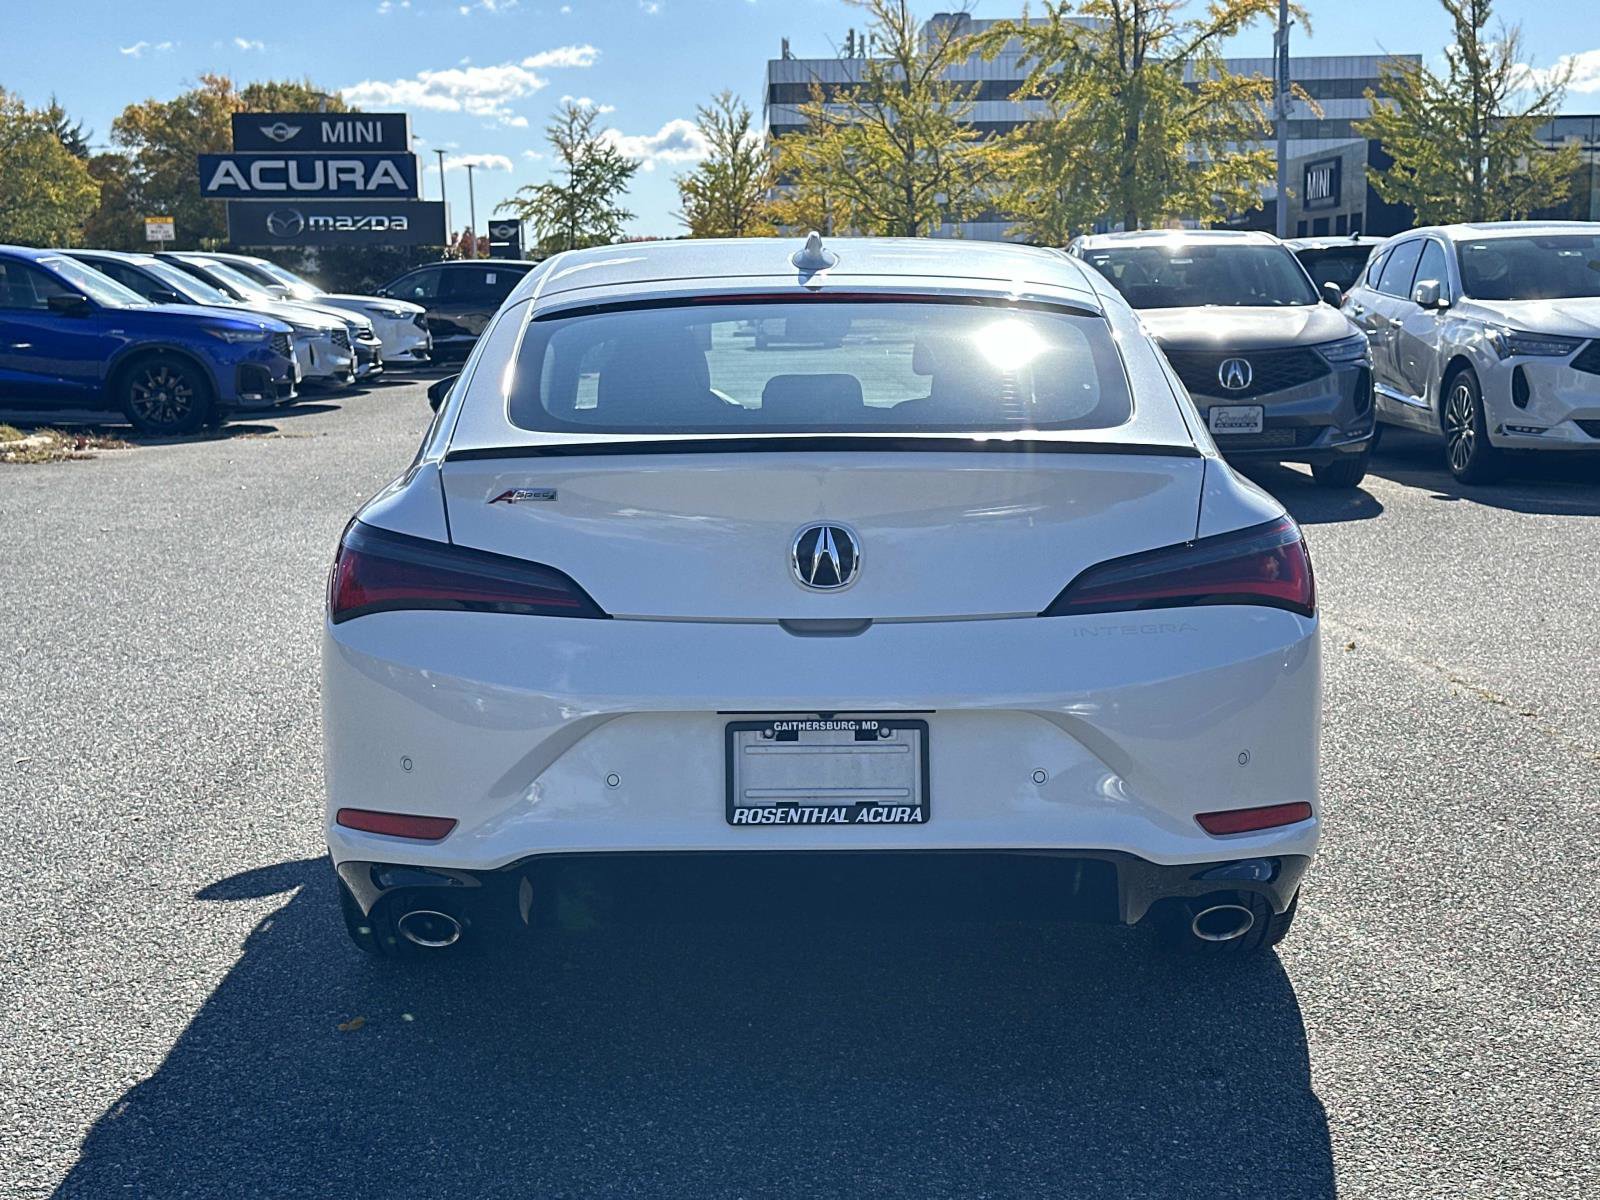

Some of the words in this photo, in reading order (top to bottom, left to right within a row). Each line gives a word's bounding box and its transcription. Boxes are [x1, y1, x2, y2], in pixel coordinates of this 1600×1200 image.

[321, 121, 383, 143] MINI
[207, 160, 409, 191] ACURA
[1307, 168, 1330, 200] MINI
[309, 216, 408, 231] mazda
[1072, 623, 1200, 637] INTEGRA
[774, 721, 859, 731] GAITHERSBURG,
[862, 721, 879, 730] MD
[733, 808, 849, 824] ROSENTHAL
[856, 807, 923, 823] ACURA
